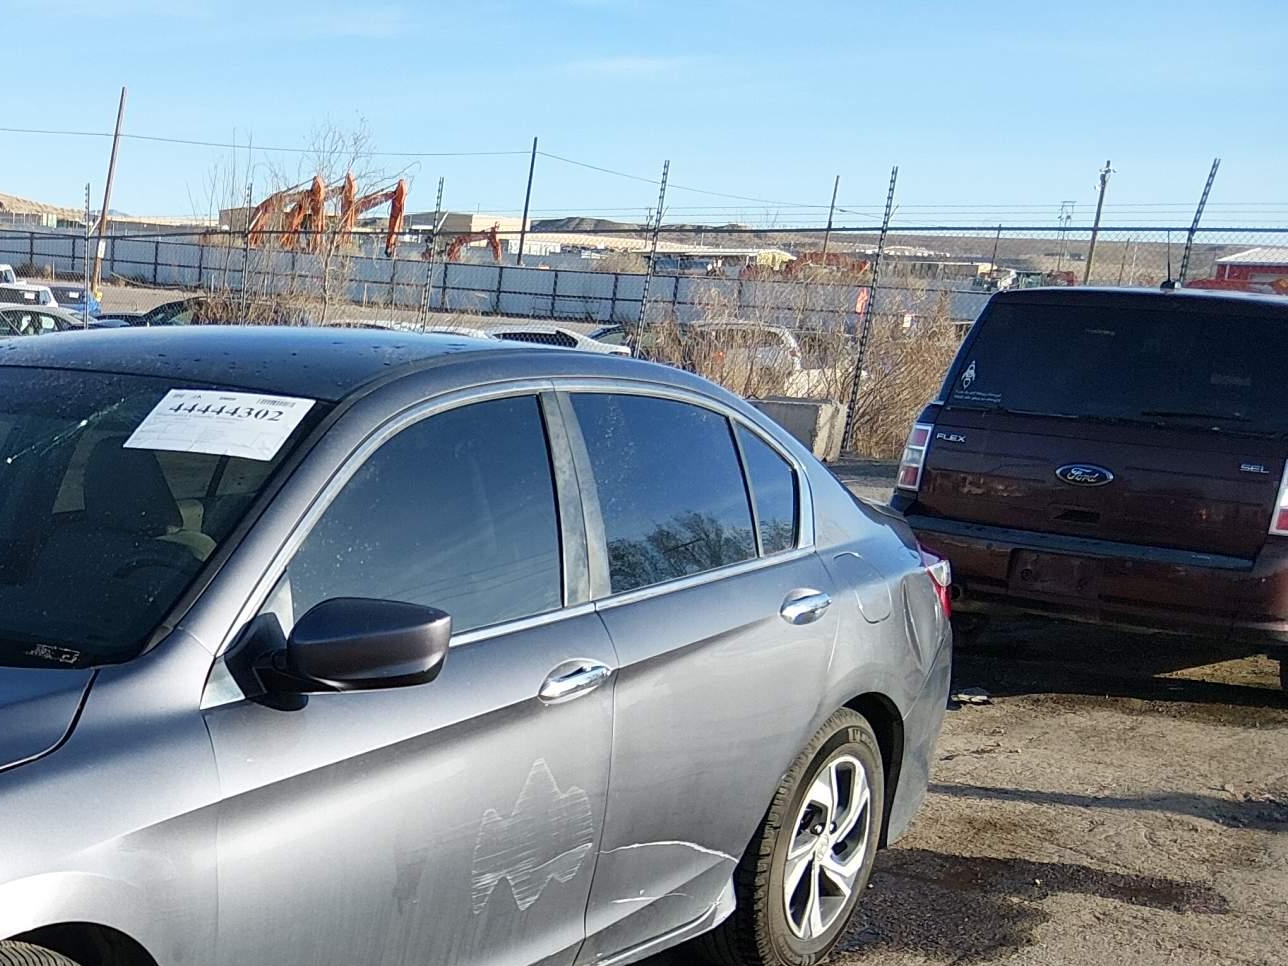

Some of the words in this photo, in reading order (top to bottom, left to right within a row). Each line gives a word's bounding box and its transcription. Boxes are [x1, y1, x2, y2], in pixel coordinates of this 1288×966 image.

[168, 402, 284, 422] 44444302
[936, 432, 967, 443] FLEX
[1066, 467, 1099, 482] Ford
[1239, 463, 1270, 474] SEL
